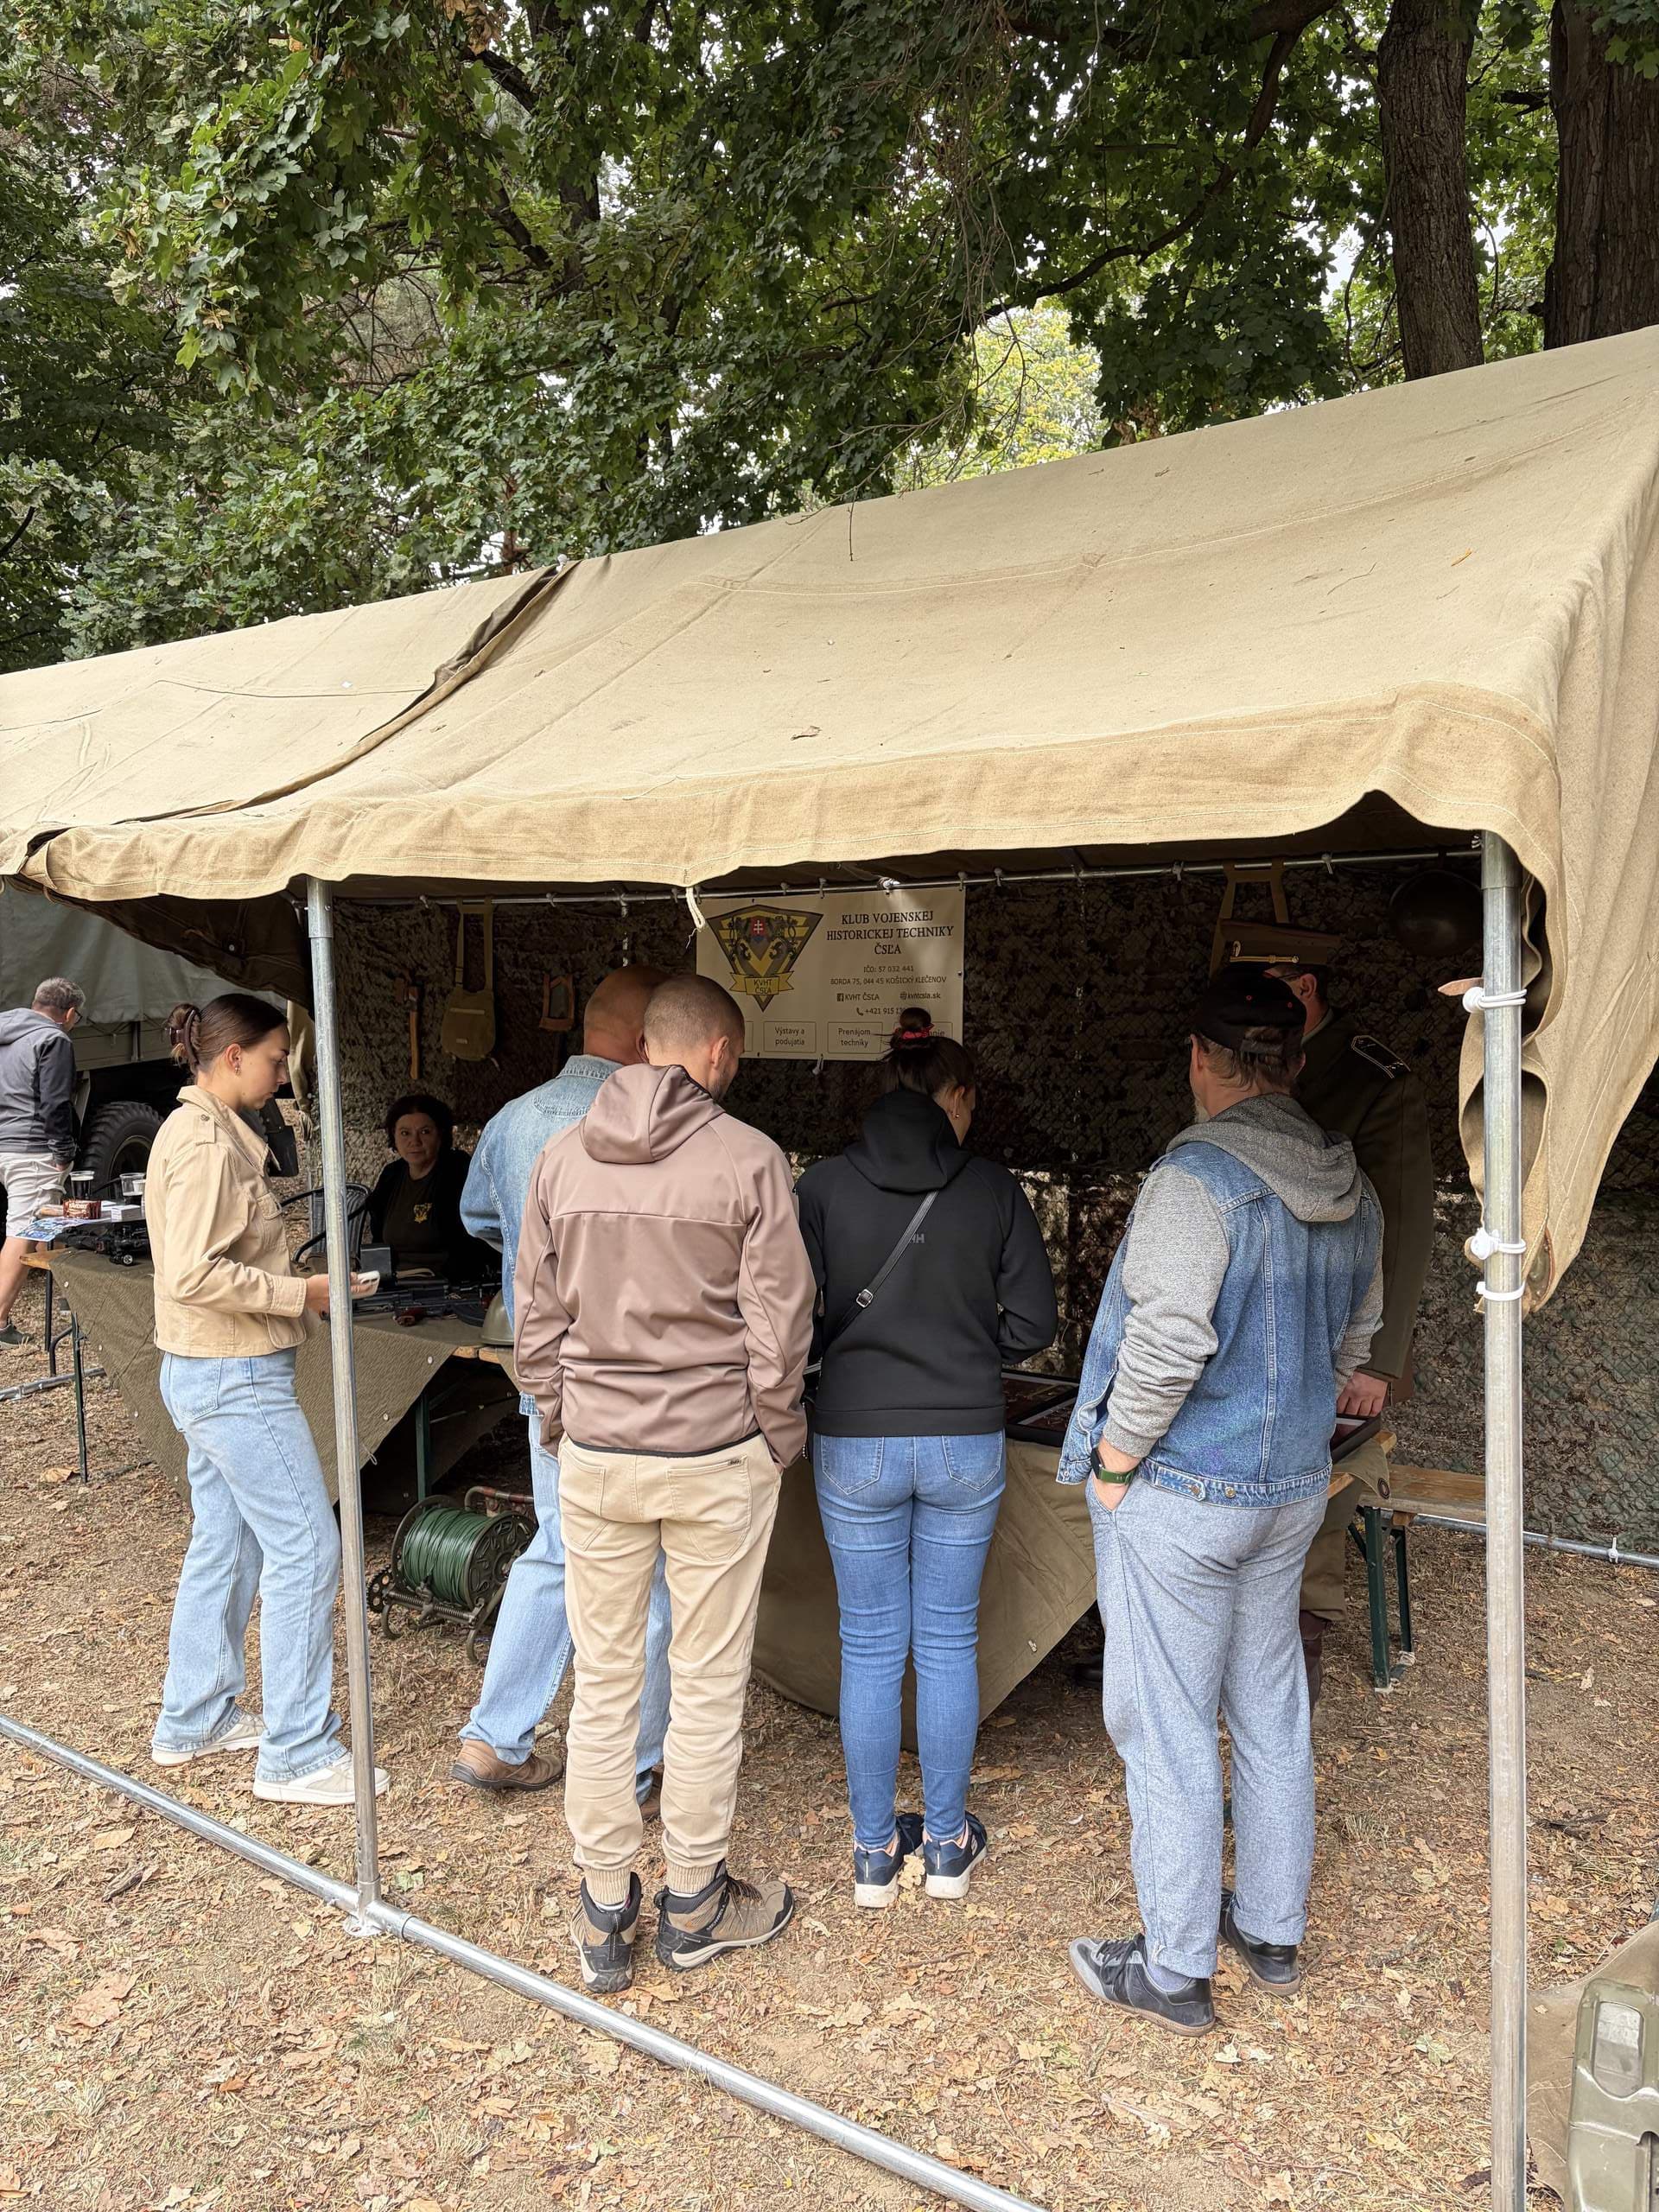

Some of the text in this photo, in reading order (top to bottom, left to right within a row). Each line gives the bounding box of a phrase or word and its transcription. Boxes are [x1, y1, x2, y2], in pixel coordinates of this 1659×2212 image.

[842, 911, 934, 925] KLUB VOJENSKEJ
[827, 925, 955, 940] HISTORICKEJ TECHNIKY
[774, 1027, 799, 1036] Výstavy
[837, 1027, 871, 1037] Prenájom
[775, 1038, 805, 1046] podujatia
[840, 1039, 869, 1048] techniky
